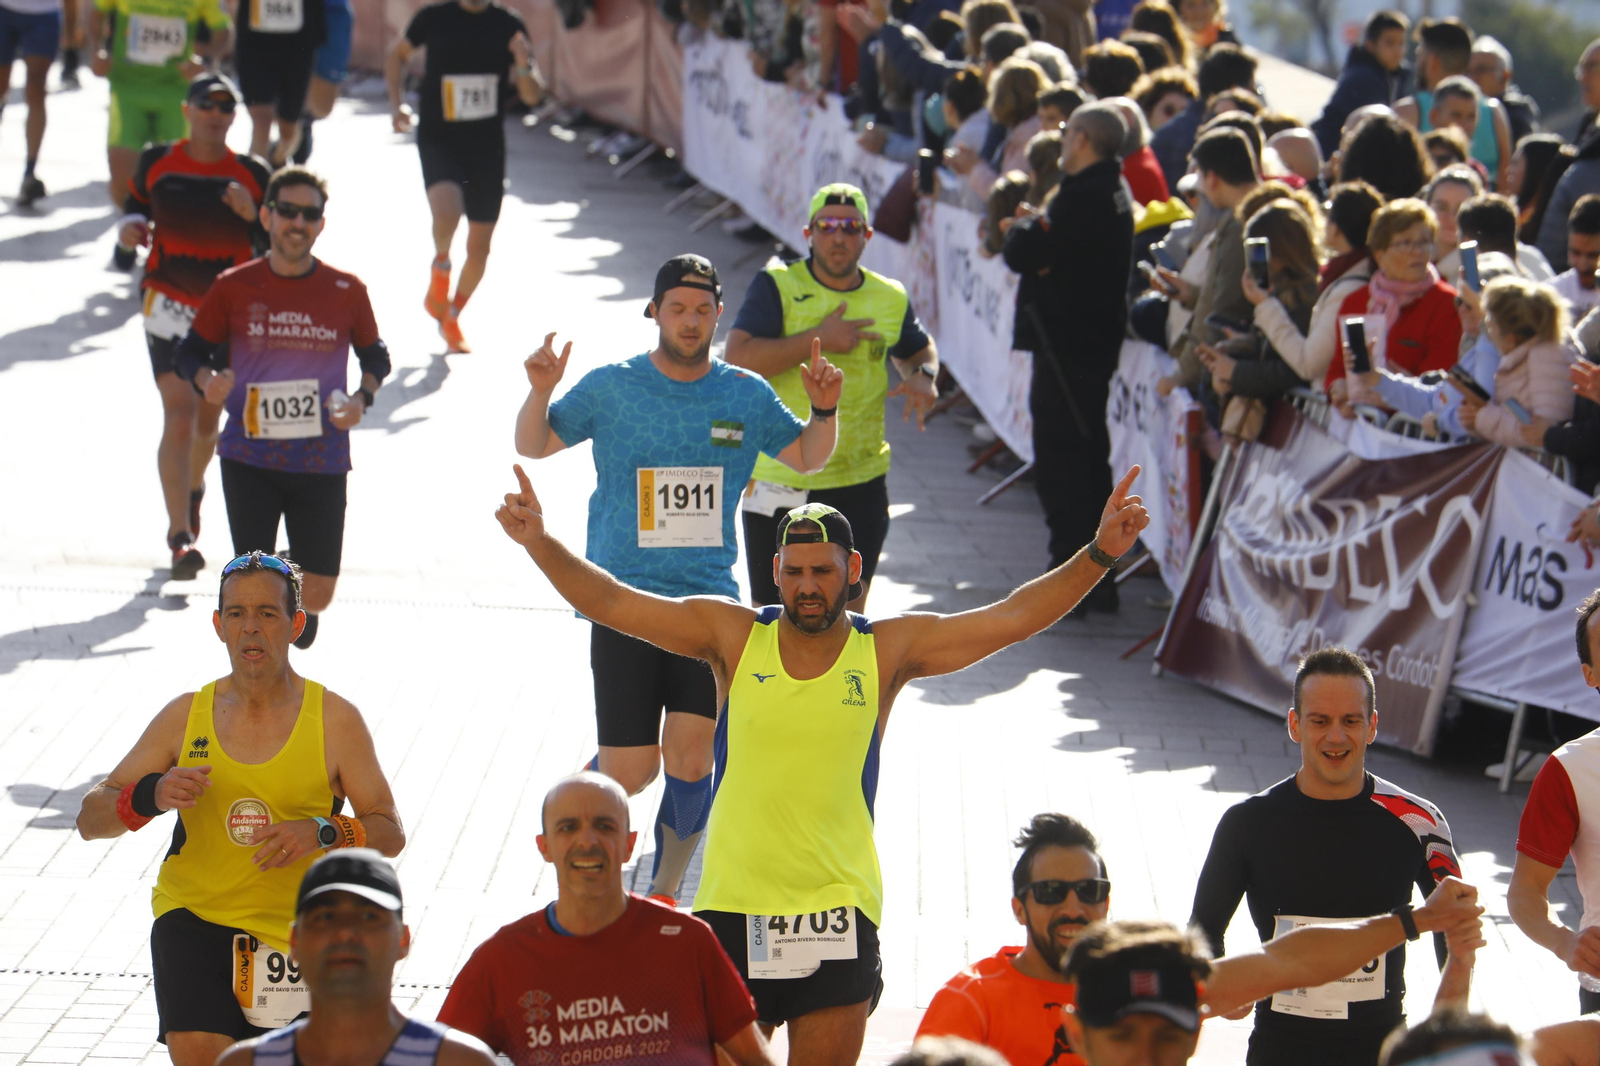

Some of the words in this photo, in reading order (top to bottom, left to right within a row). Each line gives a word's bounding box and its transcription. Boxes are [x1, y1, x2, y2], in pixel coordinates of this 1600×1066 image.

[269, 311, 312, 325] MEDIA
[247, 322, 265, 336] 36
[268, 323, 338, 341] MARATÓN
[261, 395, 315, 419] 1032
[658, 484, 714, 510] 1911
[231, 816, 267, 825] Andarines
[340, 815, 356, 847] CORR
[768, 906, 850, 935] 4703
[556, 995, 625, 1022] MEDIA
[525, 1024, 552, 1049] 36
[558, 1008, 669, 1045] MARATÓN
[638, 1039, 671, 1055] 2022
